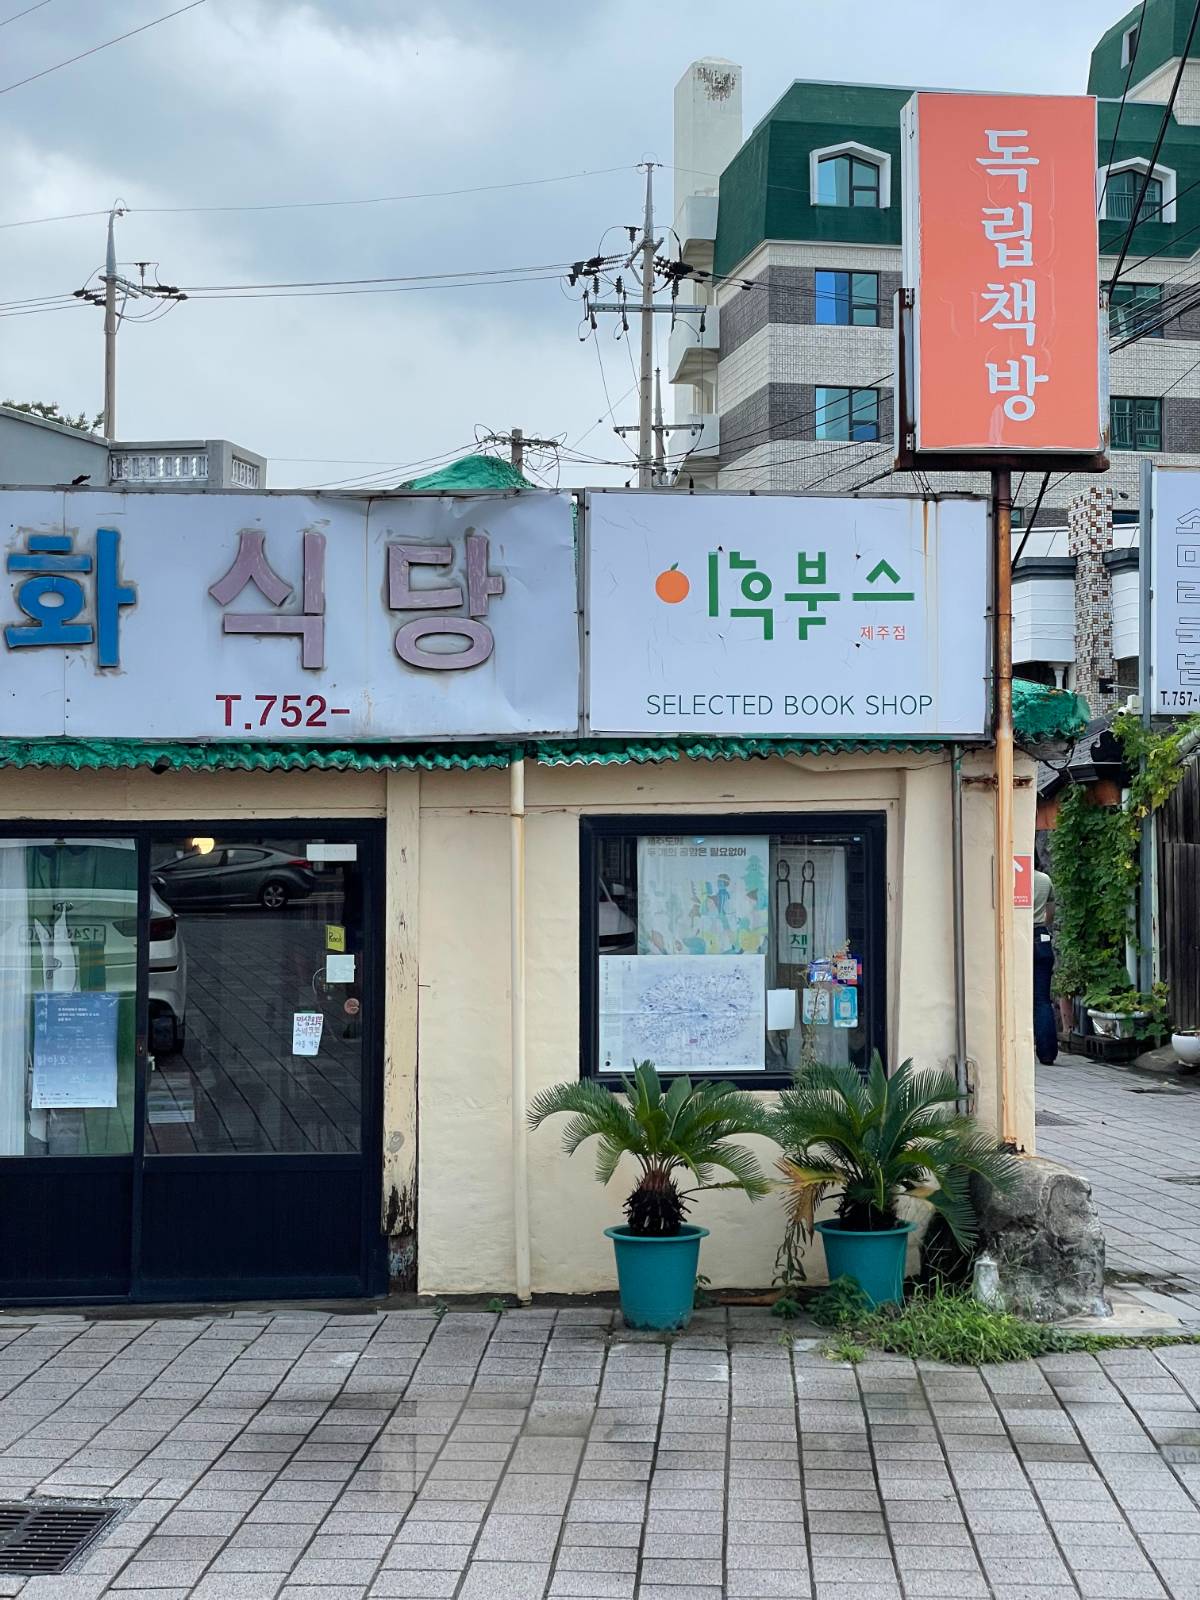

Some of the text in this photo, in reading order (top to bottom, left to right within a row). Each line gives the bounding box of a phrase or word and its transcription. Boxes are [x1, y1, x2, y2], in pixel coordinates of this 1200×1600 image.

[976, 129, 1049, 421] 독립책방
[4, 528, 137, 667] 화
[860, 624, 906, 641] 제주점
[646, 694, 933, 716] SELECTED BOOK SHOP
[1160, 690, 1200, 706] T.757-
[215, 694, 351, 730] T.752-
[789, 934, 808, 955] 책
